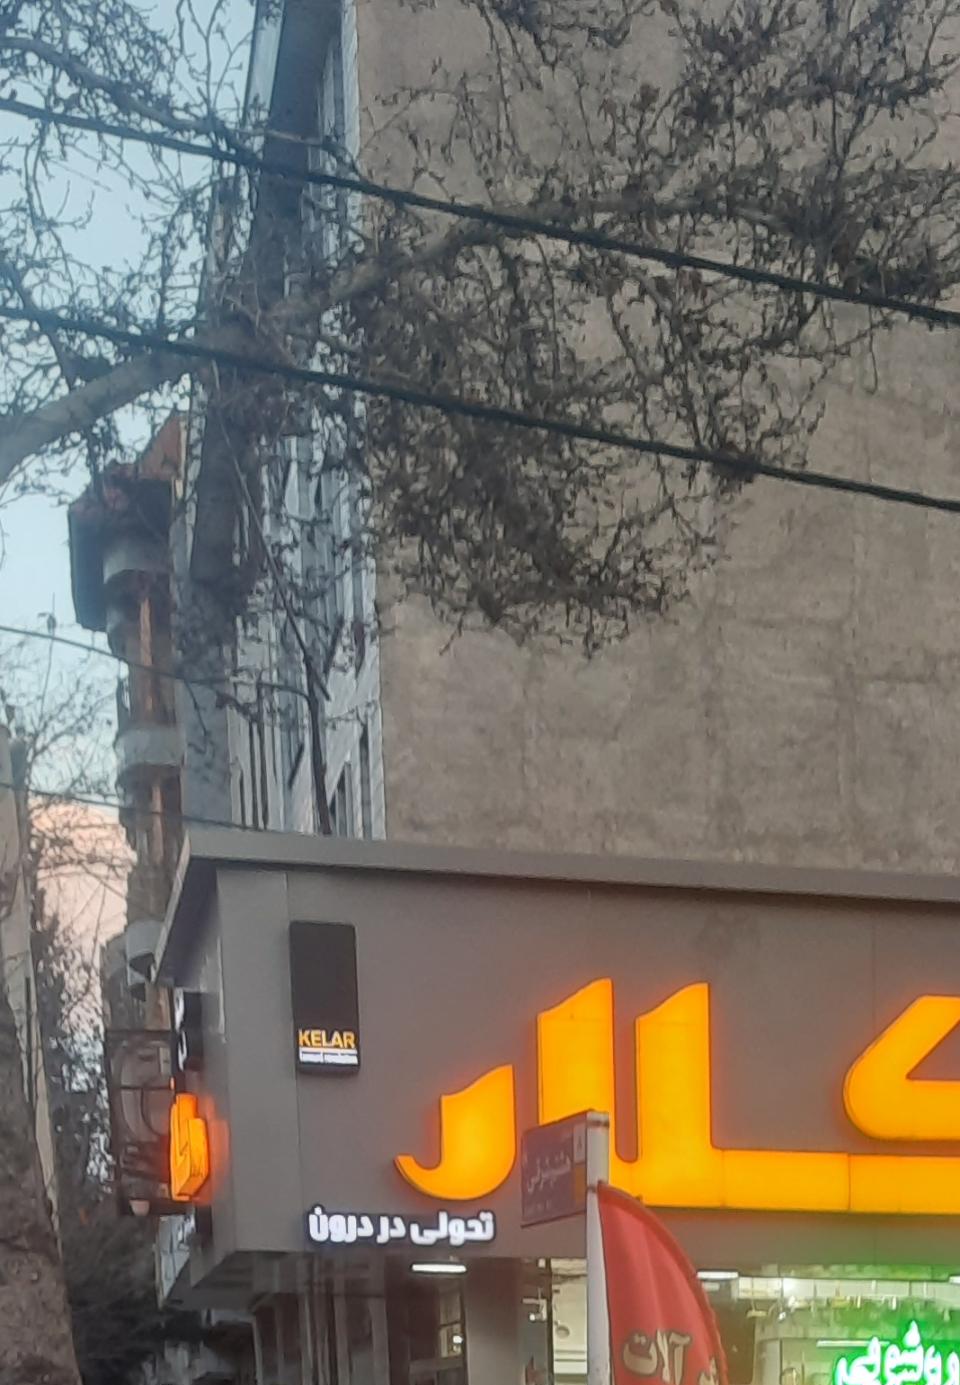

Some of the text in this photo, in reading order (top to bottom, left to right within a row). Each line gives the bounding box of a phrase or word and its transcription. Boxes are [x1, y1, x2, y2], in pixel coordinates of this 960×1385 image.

[298, 1028, 356, 1049] KELAR
[308, 1205, 495, 1246] تحولی در درون
